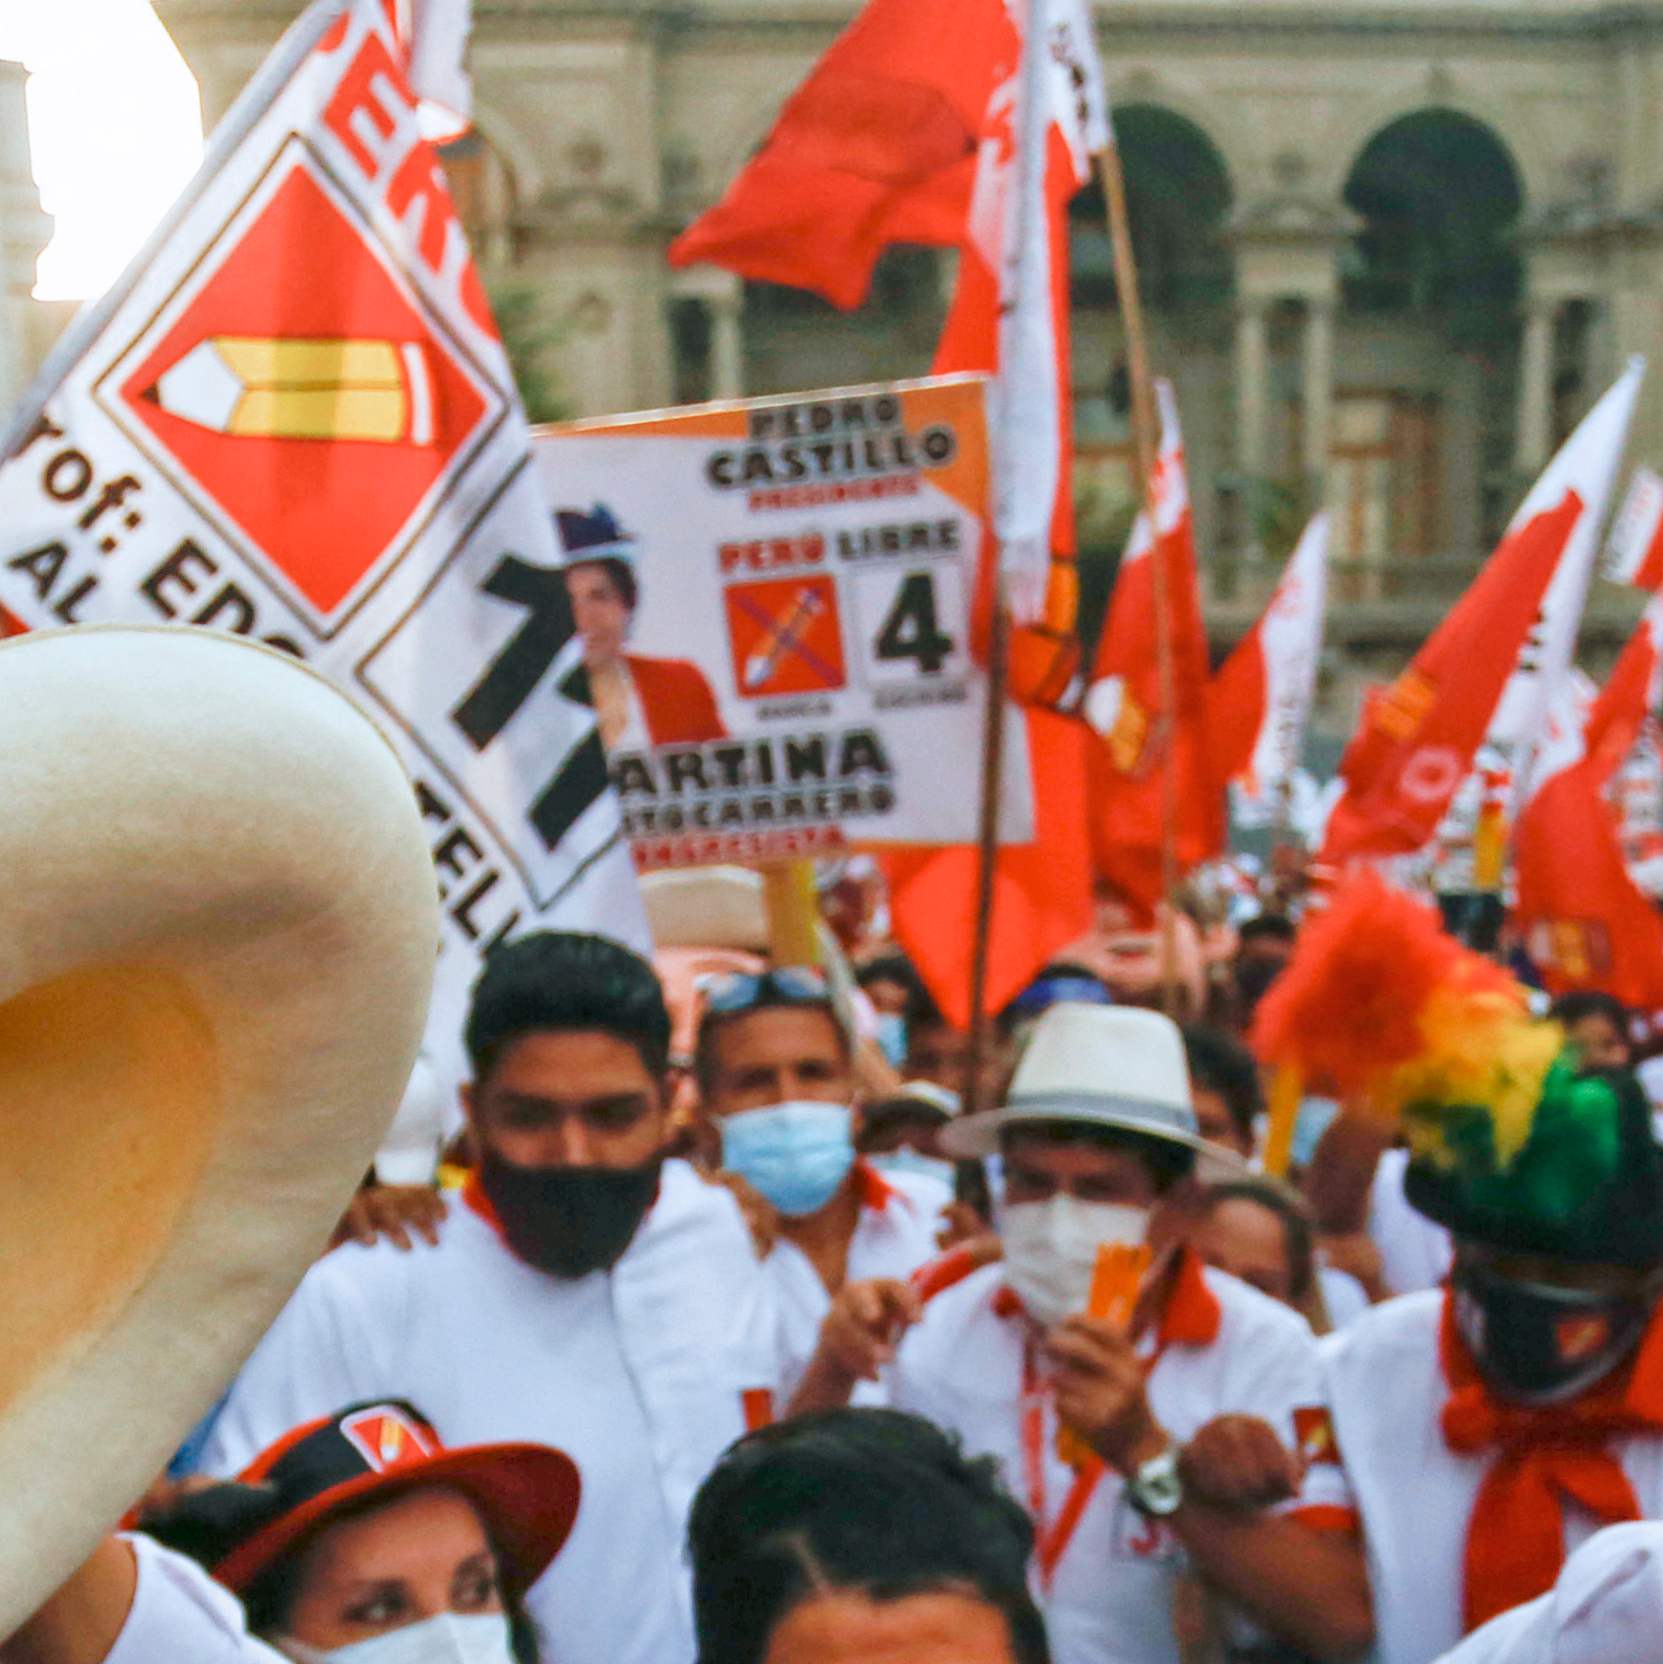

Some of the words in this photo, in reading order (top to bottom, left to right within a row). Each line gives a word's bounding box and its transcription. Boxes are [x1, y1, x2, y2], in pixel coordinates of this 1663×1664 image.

[708, 428, 952, 487] CASTILLO
[138, 537, 306, 660] ED
[875, 568, 954, 677] 4
